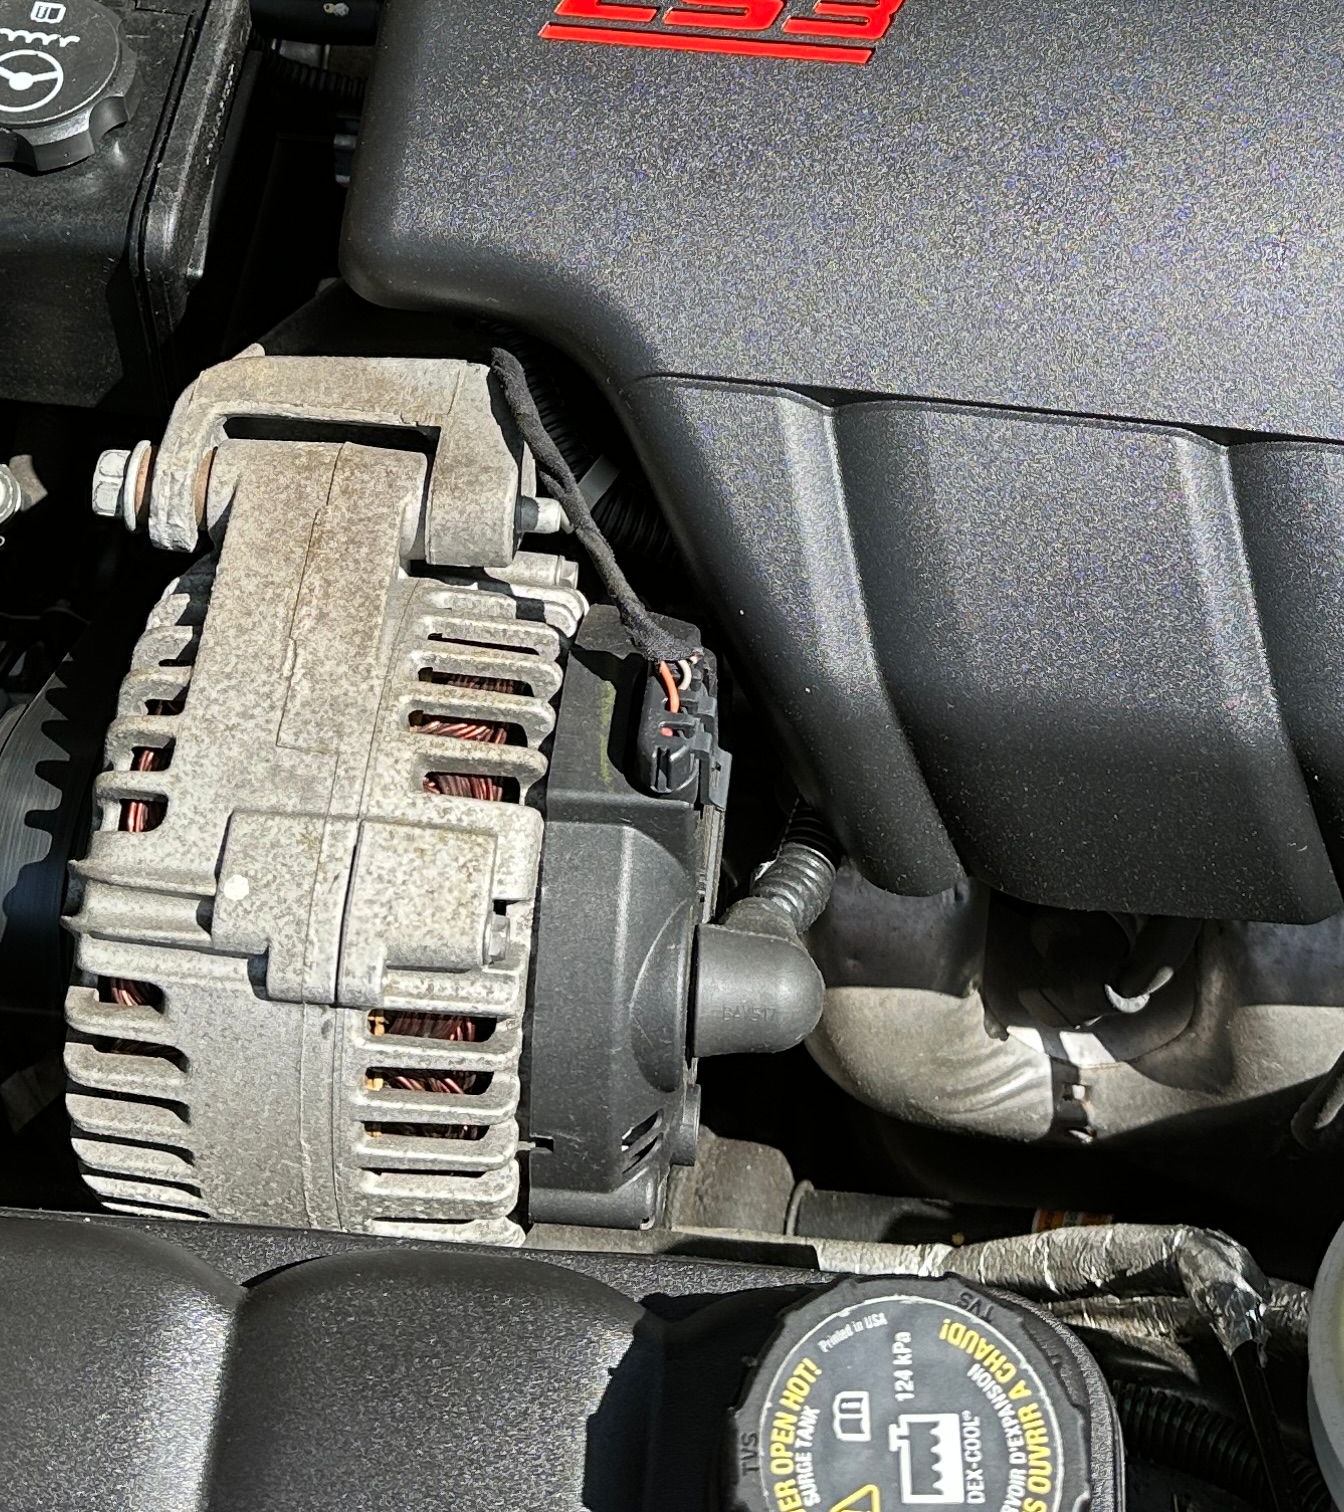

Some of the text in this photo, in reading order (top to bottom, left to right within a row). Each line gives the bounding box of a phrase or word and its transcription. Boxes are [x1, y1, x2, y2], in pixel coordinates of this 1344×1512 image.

[817, 1312, 888, 1352] Printed in USA
[939, 1318, 1017, 1384] CHAUD!
[779, 1357, 823, 1411] HOT!
[892, 1331, 915, 1401] 124 kPa
[1008, 1379, 1032, 1401] A
[770, 1410, 799, 1475] OPEN
[967, 1363, 1027, 1464] D'EXPANSION
[741, 1432, 759, 1475] TVS
[794, 1405, 821, 1507] SURGE TANK
[1018, 1402, 1053, 1495] OUVRIR
